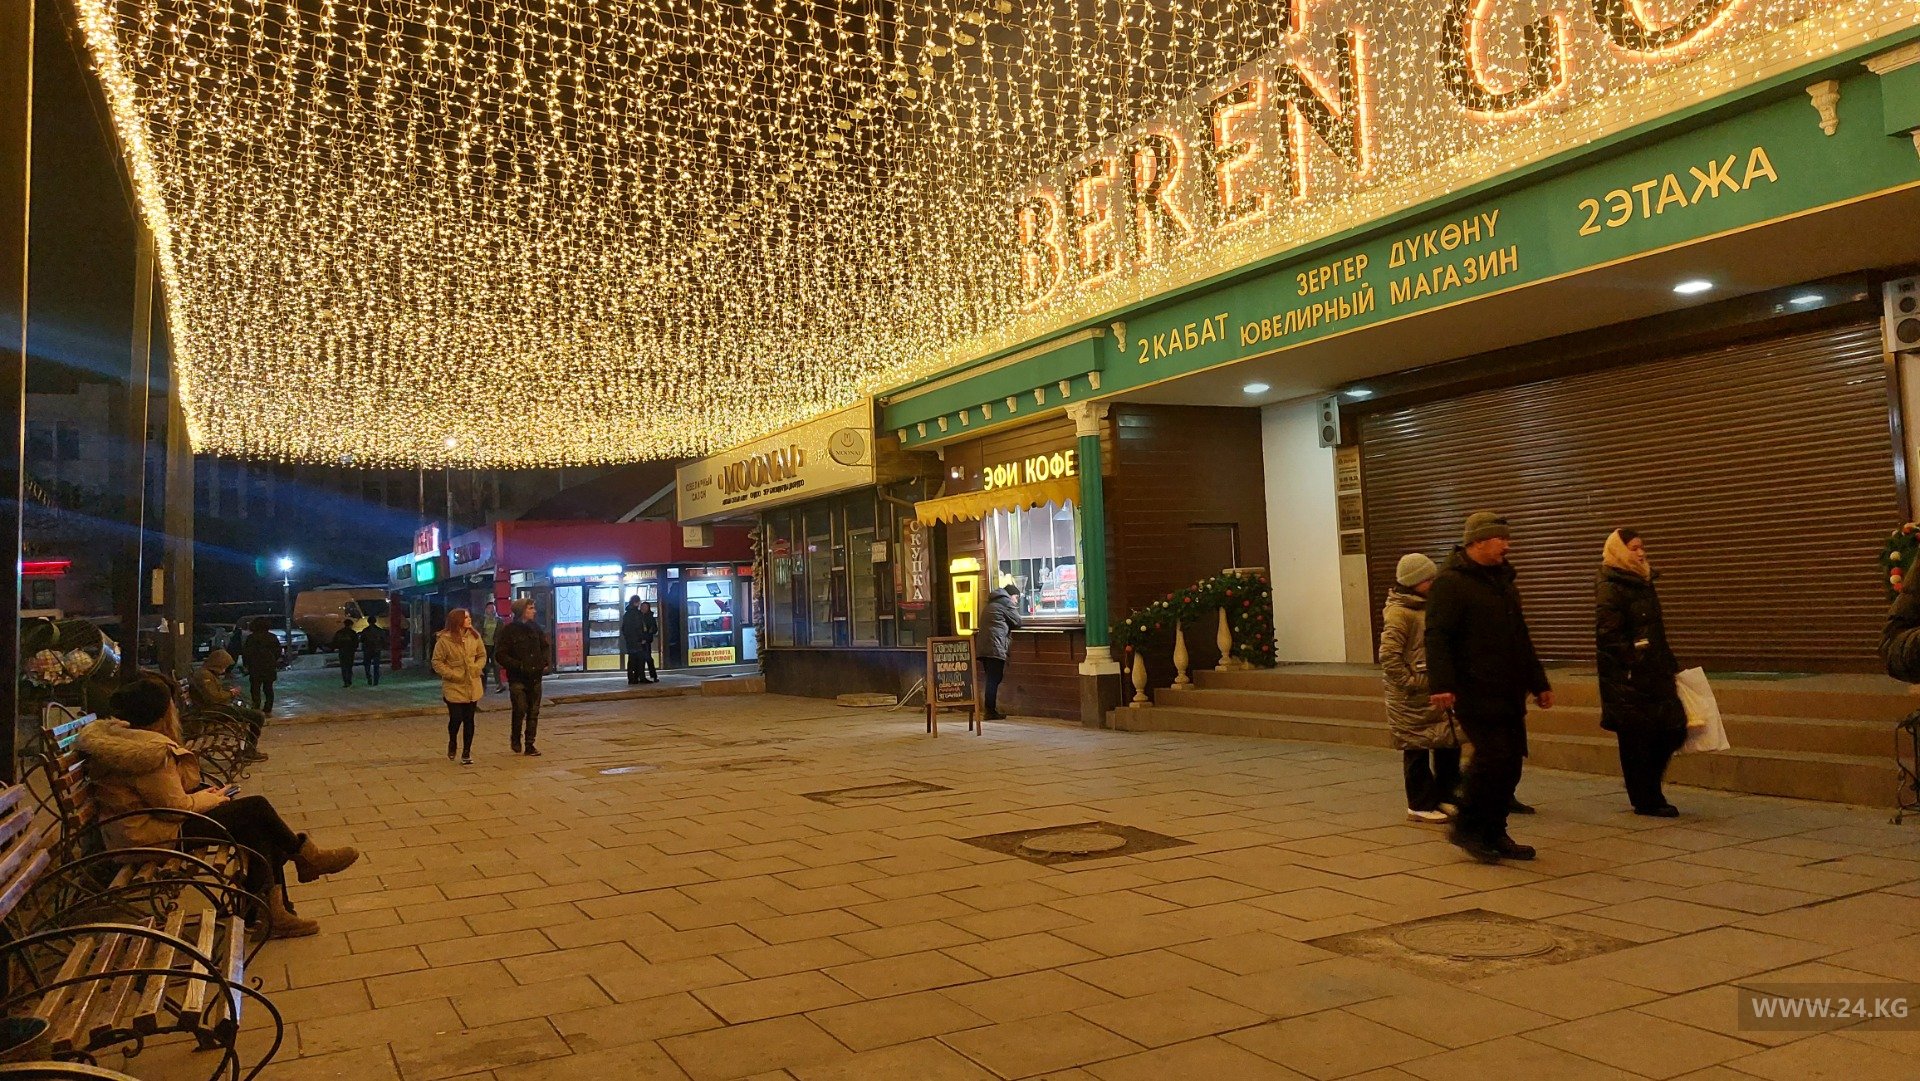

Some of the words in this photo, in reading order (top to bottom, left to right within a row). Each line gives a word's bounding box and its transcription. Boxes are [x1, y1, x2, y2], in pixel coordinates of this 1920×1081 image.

[1008, 25, 1375, 312] BEREN
[1296, 253, 1369, 297] ЗЕРГЕР
[1388, 208, 1500, 269] ДҮКӨНҮ
[1239, 281, 1375, 348] ЮВЕЛИРНЫЙ
[1389, 244, 1518, 306] МАГАЗИН
[983, 461, 1019, 491] ЭФИ
[1025, 449, 1076, 483] КОФЕ
[909, 520, 924, 600] СКУПКА
[937, 661, 968, 672] КАКАО
